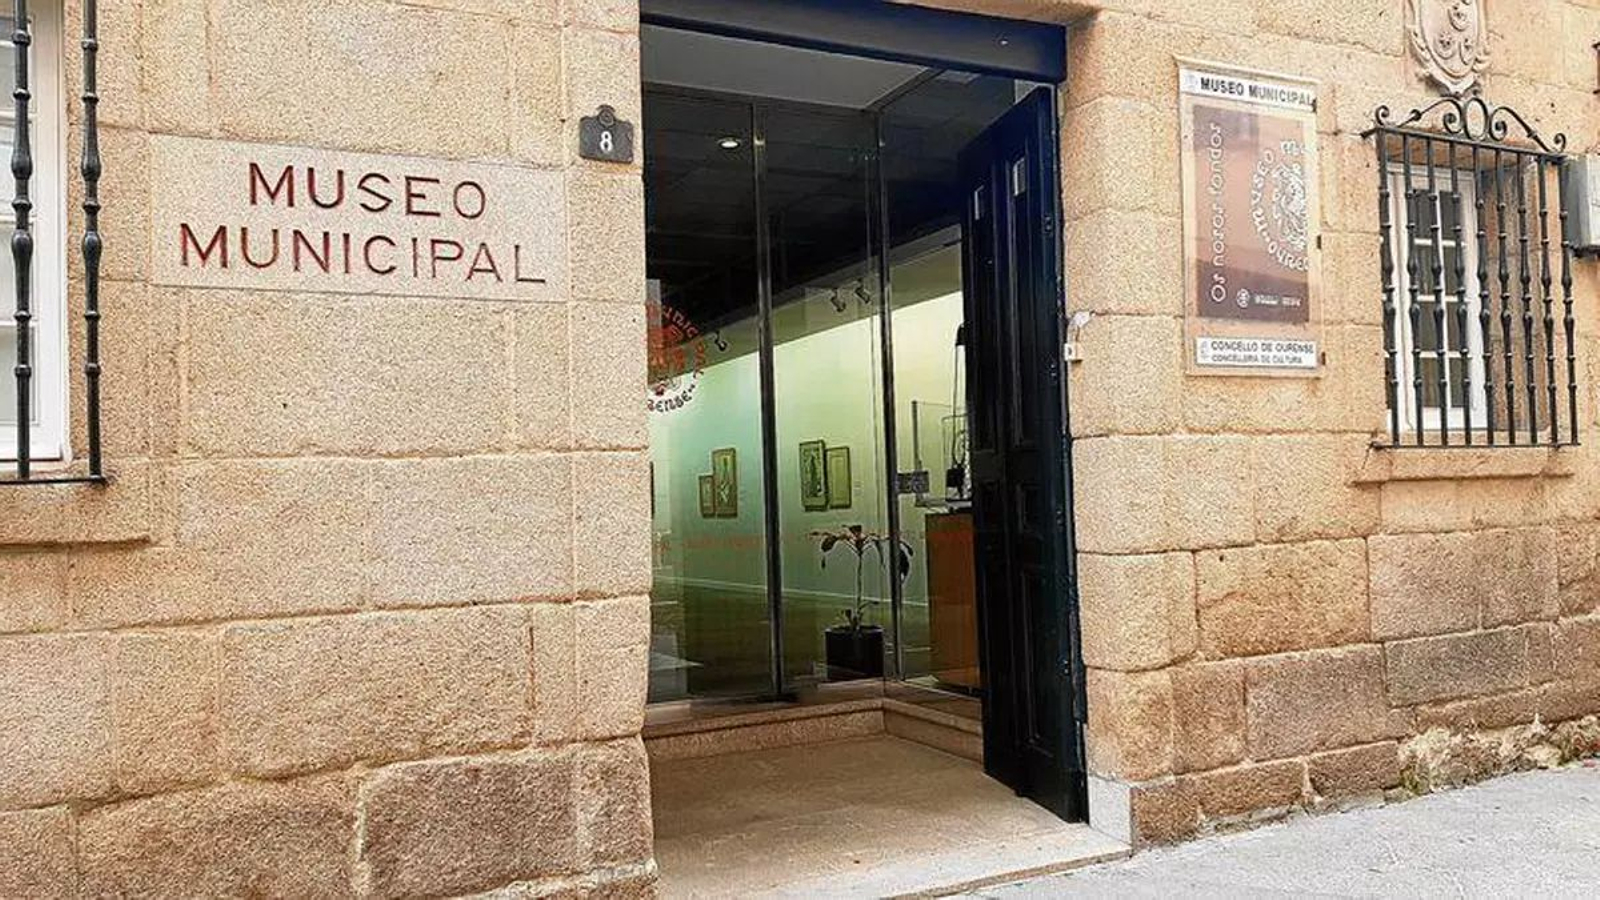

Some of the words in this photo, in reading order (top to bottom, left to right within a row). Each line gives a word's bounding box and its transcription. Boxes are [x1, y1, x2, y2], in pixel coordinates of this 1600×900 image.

[1200, 77, 1245, 96] MUSEO
[1248, 84, 1314, 105] MUNICIPAL
[599, 130, 613, 153] 8
[1208, 122, 1223, 196] fondos
[248, 162, 486, 220] MUSEO
[178, 222, 548, 284] MUNICIPAL
[1212, 203, 1225, 267] nosos
[1211, 340, 1258, 352] CONCELLO
[1260, 342, 1273, 352] DE
[1275, 342, 1314, 354] OURENSE
[1260, 354, 1271, 363] DE
[1272, 355, 1303, 364] CULTURA
